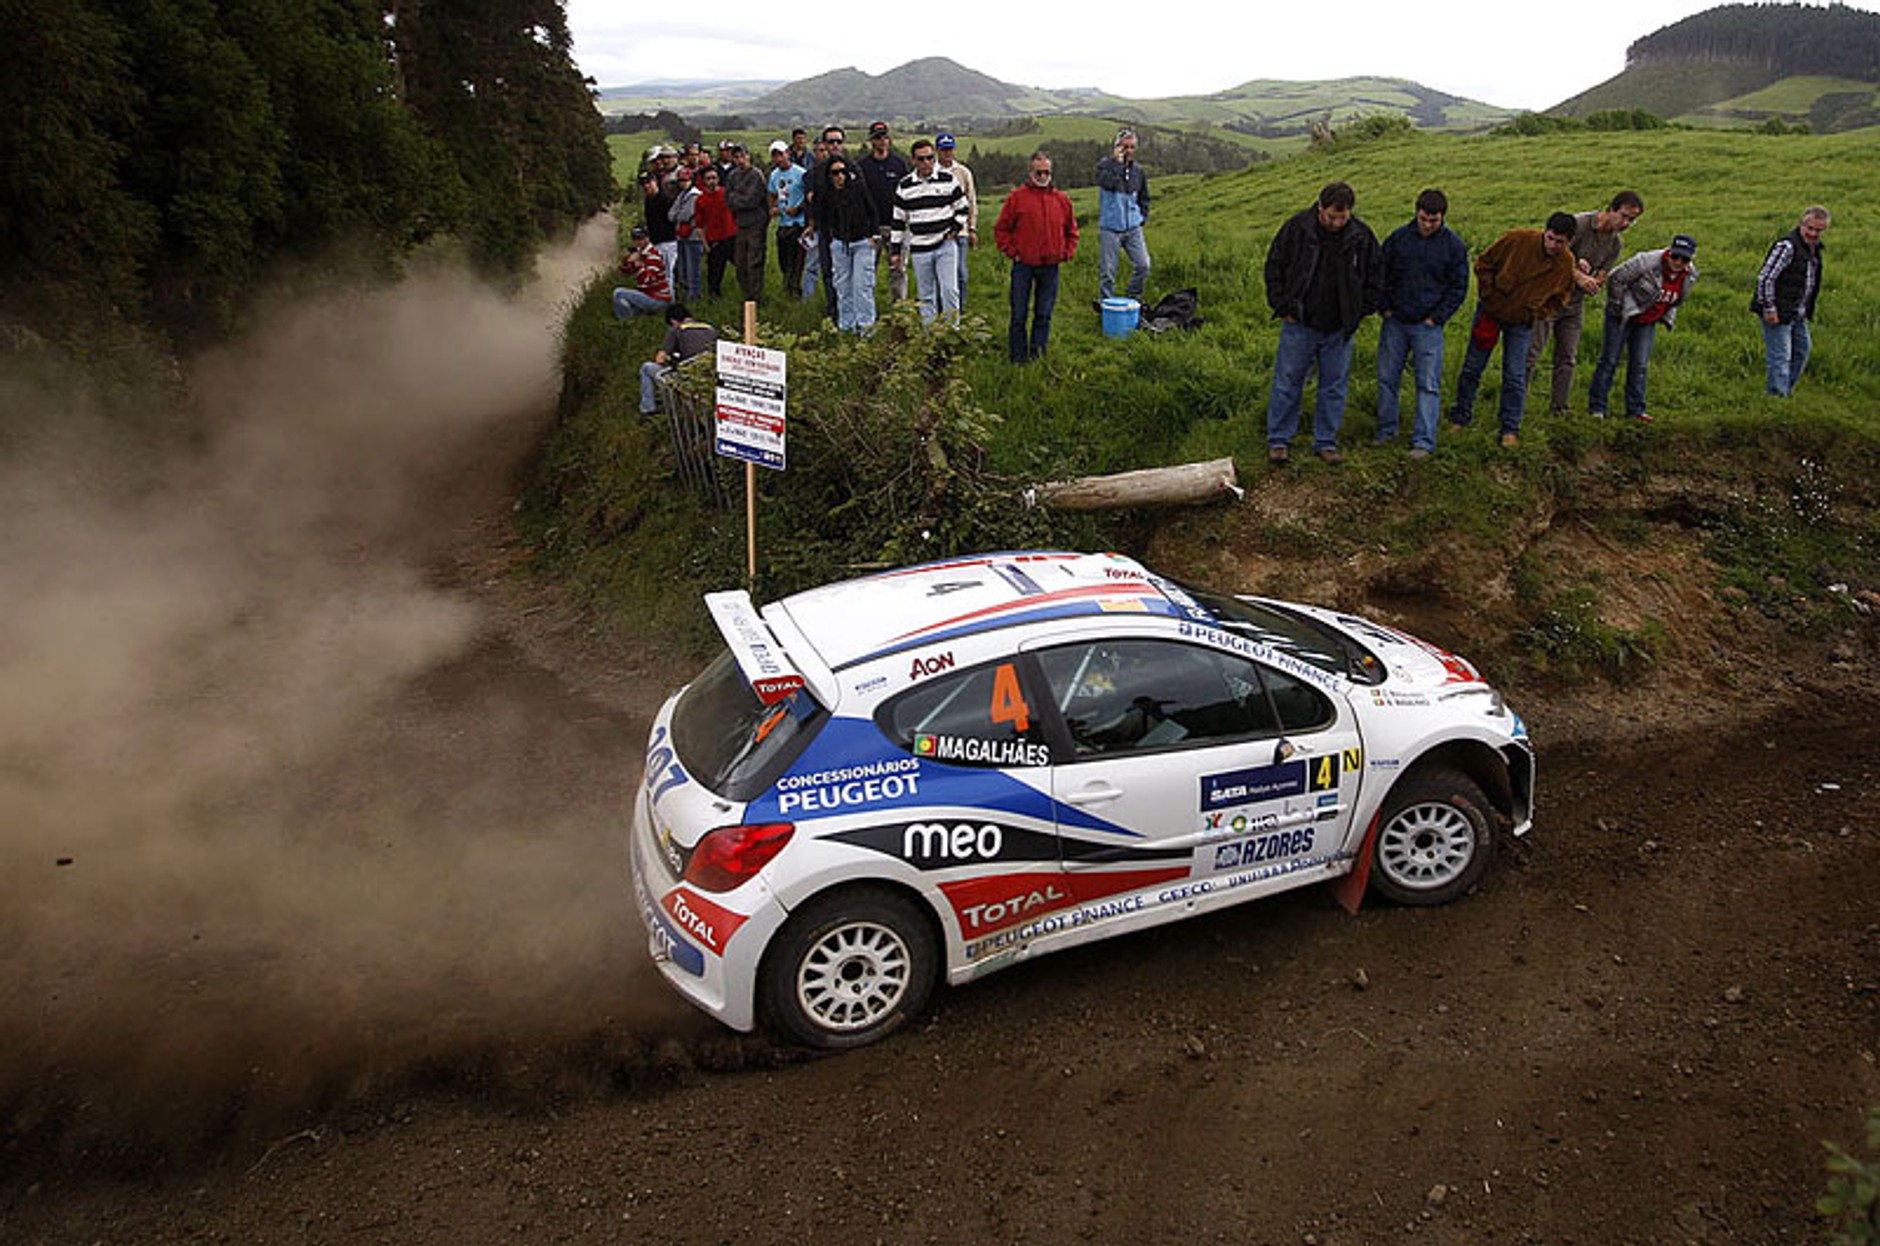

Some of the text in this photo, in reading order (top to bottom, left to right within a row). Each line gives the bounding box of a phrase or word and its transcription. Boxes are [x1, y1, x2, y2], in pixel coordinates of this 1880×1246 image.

[1103, 568, 1143, 580] TOTAL
[1196, 627, 1273, 660] PEUGEOT
[910, 652, 955, 680] AON
[759, 680, 803, 693] TOTAL
[990, 663, 1030, 732] 4
[937, 735, 1049, 766] MAGALHÃES
[1344, 749, 1360, 772] N
[777, 758, 920, 791] CONCESSIONÁRIOS
[1316, 756, 1332, 790] 4
[779, 773, 921, 814] PEUGEOT
[904, 823, 1002, 858] meo
[672, 894, 717, 947] TOTAL
[962, 885, 1065, 928] TOTAL
[981, 916, 1066, 953] PEUGEOT
[1071, 896, 1144, 926] FINANCE
